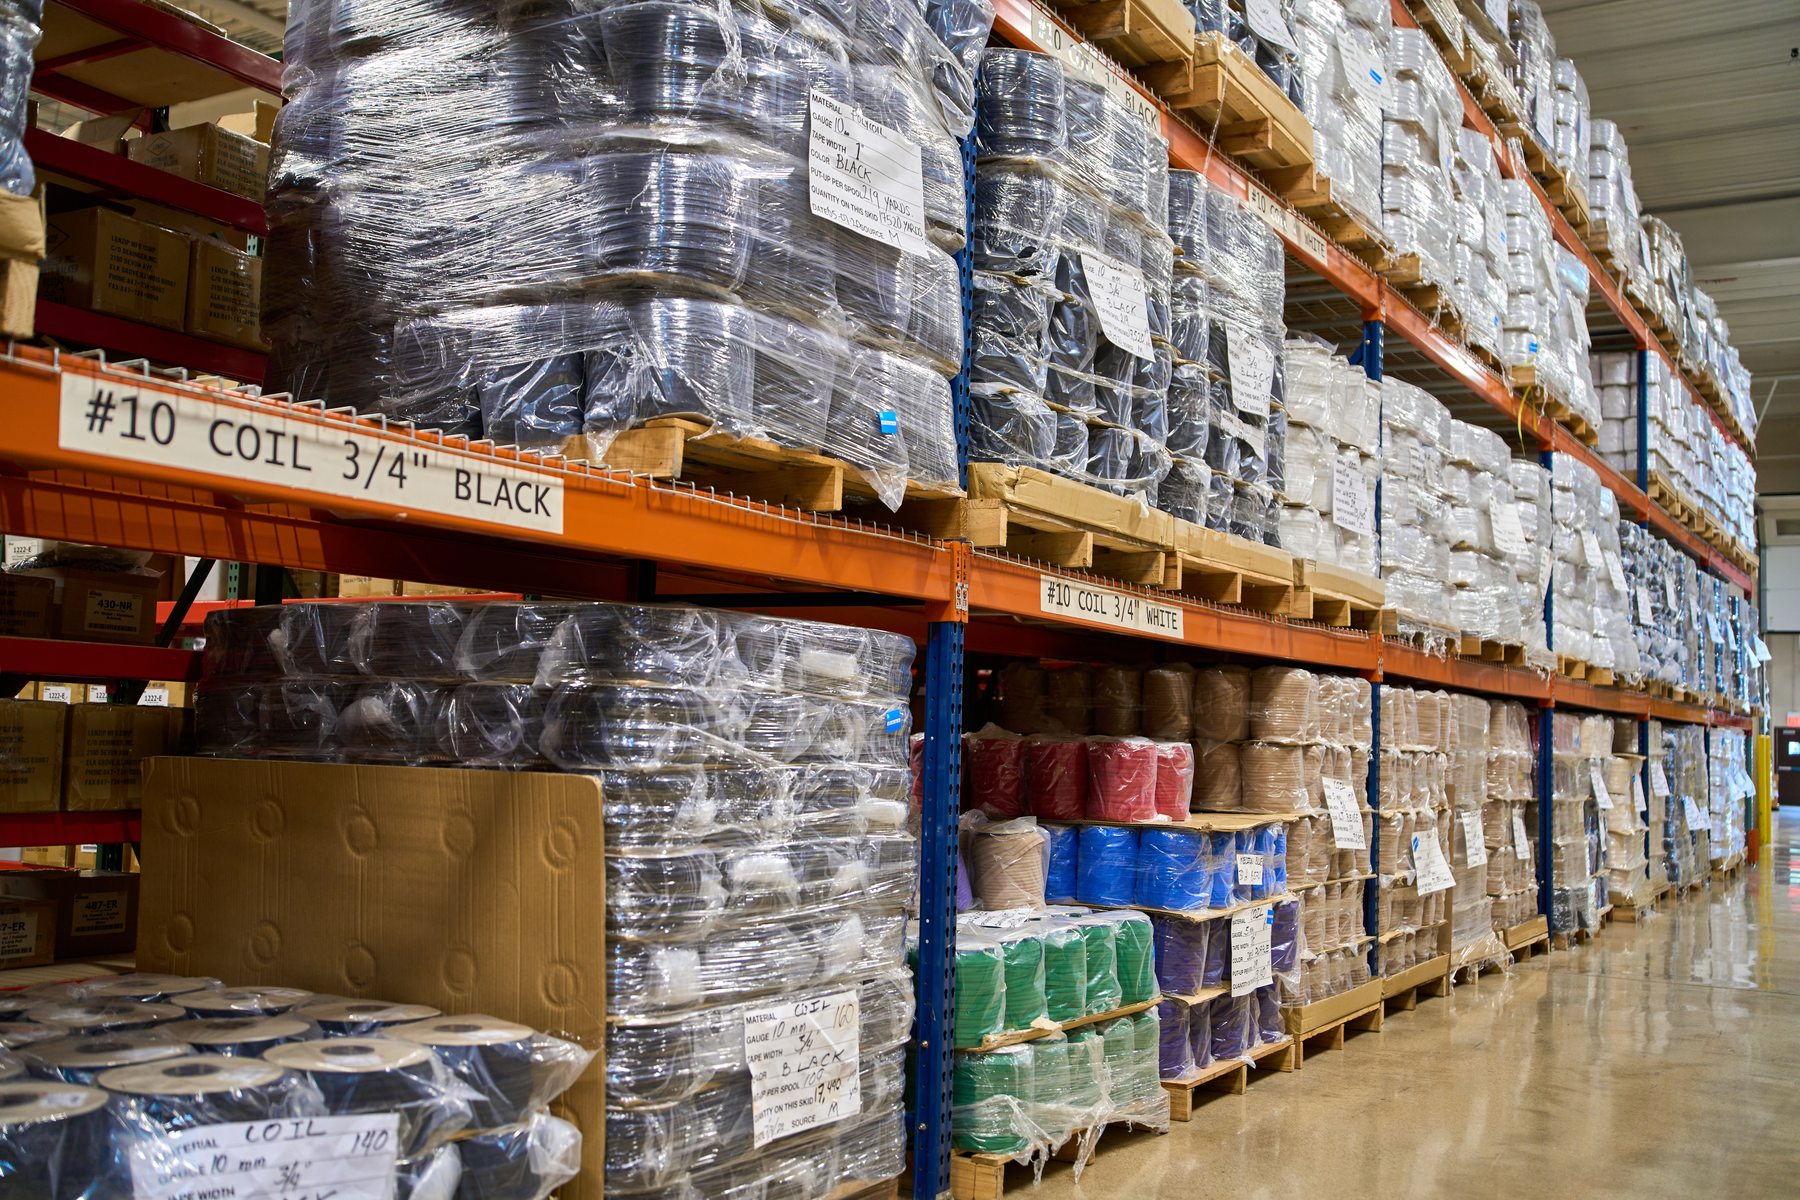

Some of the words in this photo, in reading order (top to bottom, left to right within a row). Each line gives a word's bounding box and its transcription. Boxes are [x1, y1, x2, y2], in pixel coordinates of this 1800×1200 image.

[811, 94, 843, 116] MATERIAL
[812, 112, 833, 129] GAUGE
[812, 129, 826, 143] TAPE
[826, 138, 847, 154] WIDTH
[811, 149, 831, 165] COLOR
[836, 153, 872, 183] BLACK
[811, 166, 831, 182] PUT-UP
[832, 178, 844, 189] PER
[844, 184, 863, 199] SPOOL
[811, 185, 839, 205] QUANTITY
[840, 199, 850, 209] ON
[850, 203, 864, 216] THIS
[864, 210, 879, 222] SKID
[85, 388, 176, 446] #10
[208, 419, 312, 472] COIL
[342, 440, 428, 490] 3/4"
[455, 468, 551, 518] BLACK
[98, 600, 132, 611] 430-NR
[1048, 581, 1071, 607] #10
[1078, 590, 1107, 615] COIL
[1114, 596, 1140, 622] 3/4"
[1146, 606, 1178, 630] WHITE
[85, 899, 118, 910] 487-ER
[0, 921, 25, 932] 7-ER
[745, 1012, 777, 1024] MATERIAL
[794, 1000, 831, 1017] COIL
[746, 1032, 770, 1044] GAUGE
[772, 1021, 786, 1038] 10
[763, 1049, 783, 1060] WIDTH
[782, 1049, 845, 1077] BLACK
[767, 1087, 779, 1096] PER
[780, 1082, 800, 1094] SPOOL
[784, 1101, 798, 1110] THIS
[799, 1097, 813, 1106] SKID
[245, 1120, 326, 1144] COIL
[791, 1114, 816, 1128] SOURCE
[211, 1154, 227, 1174] 10
[198, 1186, 235, 1200] WIDTH
